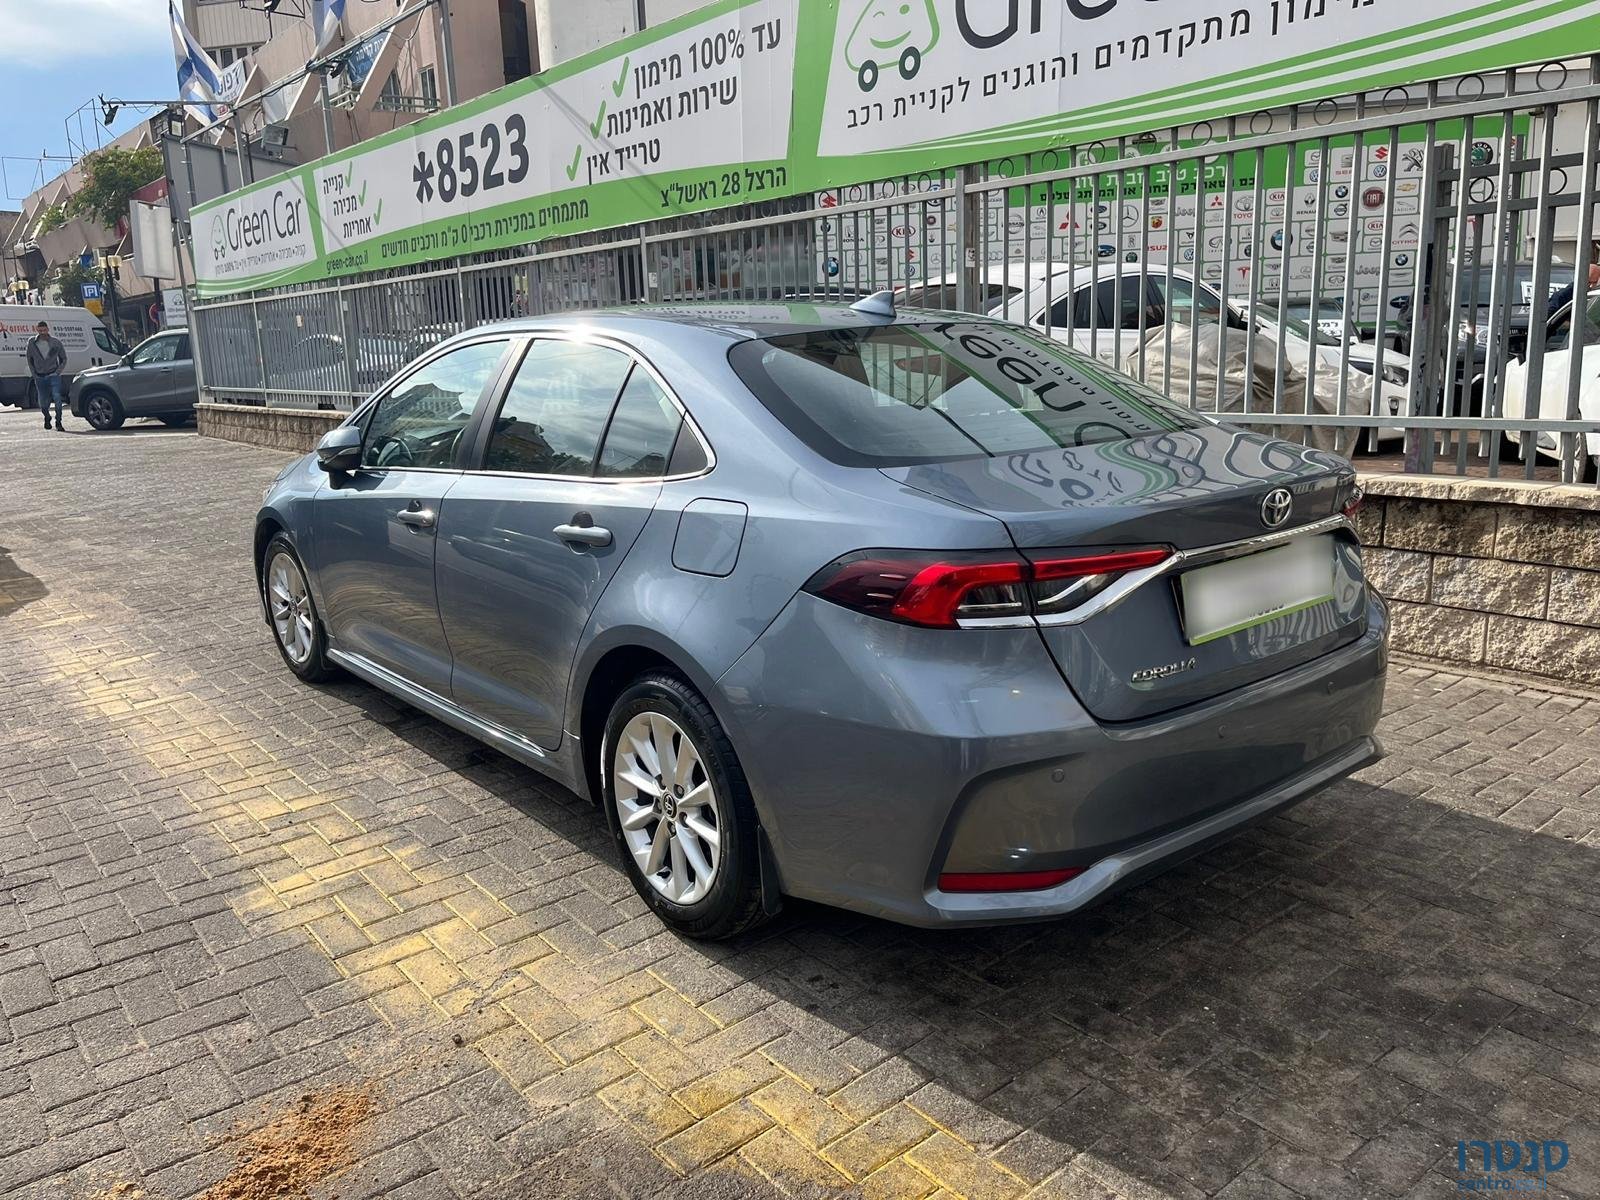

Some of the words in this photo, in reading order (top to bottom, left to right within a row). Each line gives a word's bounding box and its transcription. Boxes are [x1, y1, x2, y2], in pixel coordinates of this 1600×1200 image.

[751, 18, 781, 53] עד
[1095, 8, 1250, 70] מתקדמים
[688, 28, 745, 73] 100%
[634, 53, 682, 99] מימון
[983, 52, 1078, 97] והוגנים
[678, 76, 737, 118] שירות
[892, 76, 971, 118] לקניית
[607, 96, 671, 138] ואמינות
[847, 102, 883, 129] רכב
[614, 138, 661, 171] טרייד
[586, 151, 610, 186] אין
[745, 166, 787, 192] הרצל
[323, 174, 344, 195] קנייה
[721, 171, 740, 196] 28
[333, 195, 357, 217] מכירה
[1366, 194, 1380, 204] FIAT
[227, 208, 272, 252] Green
[273, 190, 302, 239] Car
[495, 210, 536, 237] במכירת
[538, 199, 589, 227] מתמחים
[343, 216, 372, 239] אחריות
[469, 221, 492, 242] רכבי
[381, 238, 409, 259] חדשים
[411, 232, 439, 253] ורכבים
[1130, 657, 1197, 684] COROLLA
